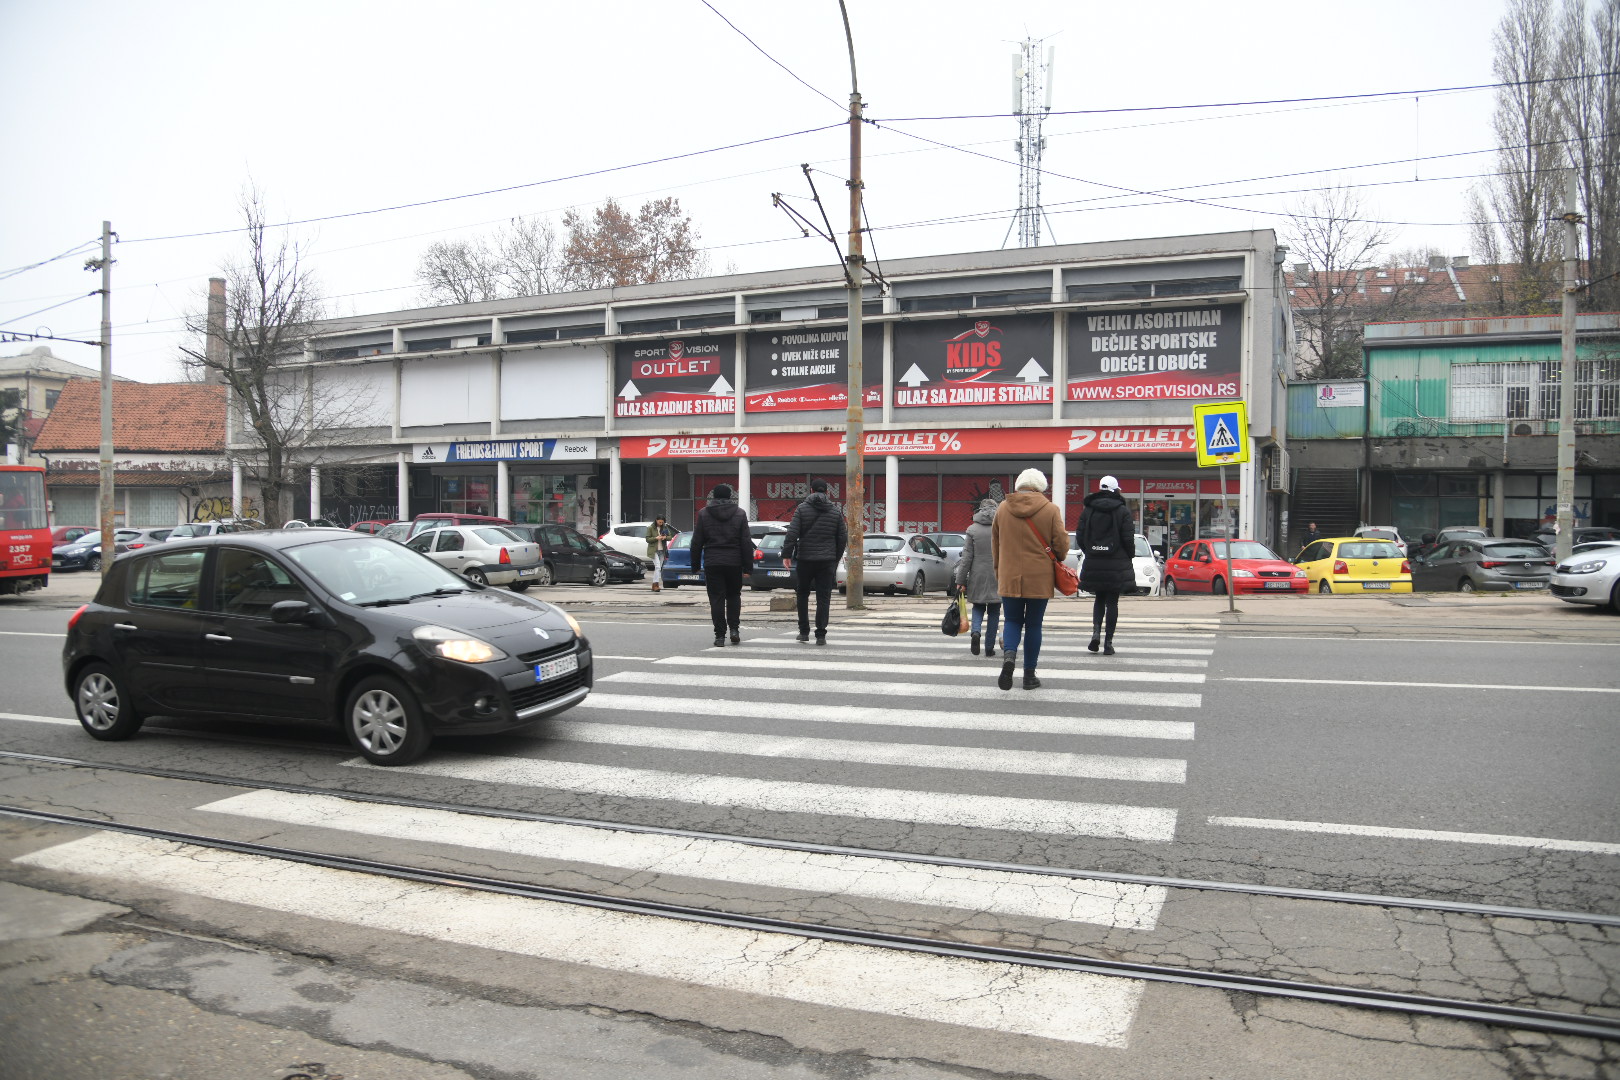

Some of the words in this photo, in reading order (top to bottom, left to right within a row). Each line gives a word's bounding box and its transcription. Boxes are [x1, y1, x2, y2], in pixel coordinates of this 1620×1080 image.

[1087, 315, 1132, 331] VELIKI
[1134, 310, 1222, 330] ASORTIMAN
[1091, 333, 1138, 352] DEČIJE
[1141, 332, 1217, 350] SPORTSKE
[634, 348, 666, 358] SPORT
[686, 345, 719, 354] VISION
[782, 352, 802, 362] UVEK
[802, 349, 819, 360] NIŽE
[820, 349, 840, 359] CENE
[947, 341, 1001, 368] KIDS
[640, 360, 711, 376] OUTLET
[1100, 354, 1146, 373] ODEĆE
[1149, 356, 1154, 371] I
[1157, 351, 1207, 371] OBUĆE
[781, 366, 809, 377] STALNE
[810, 364, 836, 375] AKCIJE
[897, 390, 928, 405] ULAZ
[930, 389, 947, 404] SA
[949, 388, 996, 403] ZADNJE
[998, 386, 1050, 401] STRANE
[1071, 382, 1237, 399] WWW.SPORTVISION.RS
[617, 402, 641, 416] ULAZ
[642, 401, 656, 415] SA
[656, 399, 693, 414] ZADNJE
[694, 397, 735, 413] STRANE
[669, 437, 730, 449] OUTLET
[866, 432, 938, 445] OUTLET
[1100, 429, 1185, 442] OUTLET
[456, 442, 518, 460] FRIENDS&FAMILY
[519, 441, 544, 458] SPORT
[564, 445, 589, 453] Reebok
[766, 483, 839, 499] URBN
[9, 544, 31, 553] 2357
